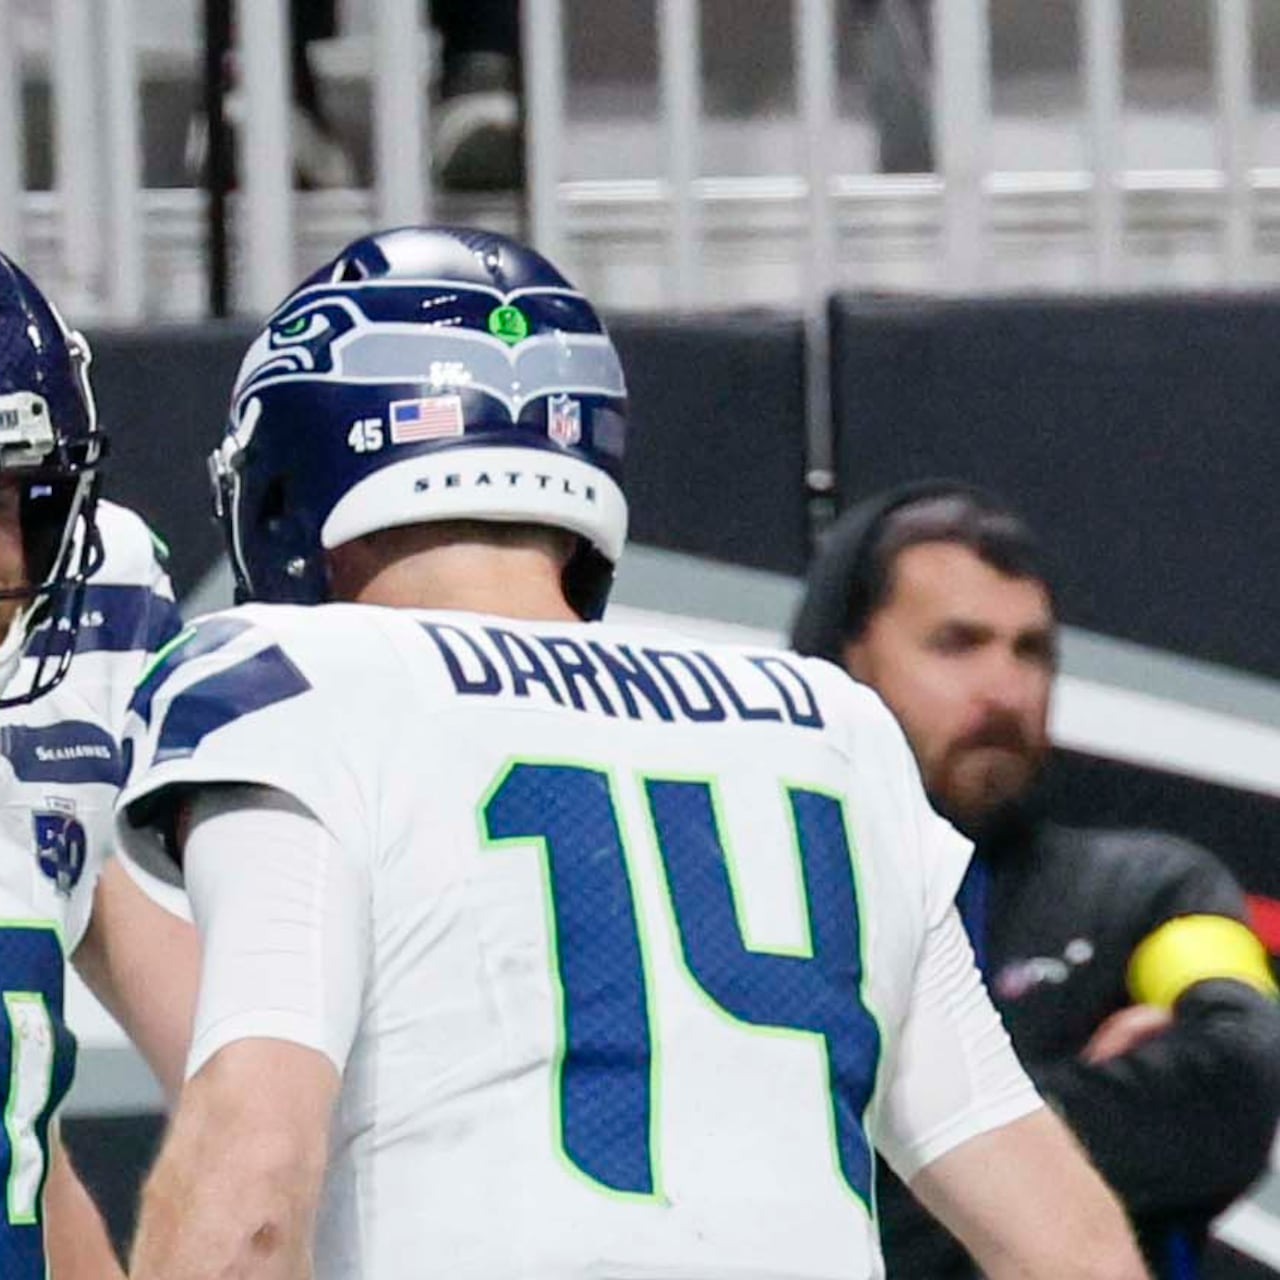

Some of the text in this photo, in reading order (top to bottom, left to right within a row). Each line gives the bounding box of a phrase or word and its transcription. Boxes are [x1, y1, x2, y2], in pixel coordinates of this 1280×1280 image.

[347, 419, 383, 453] 45
[414, 471, 597, 502] SEATTLE
[418, 621, 826, 729] DARNOLD
[35, 745, 111, 761] SEAHAWKS
[475, 754, 888, 1222] 14
